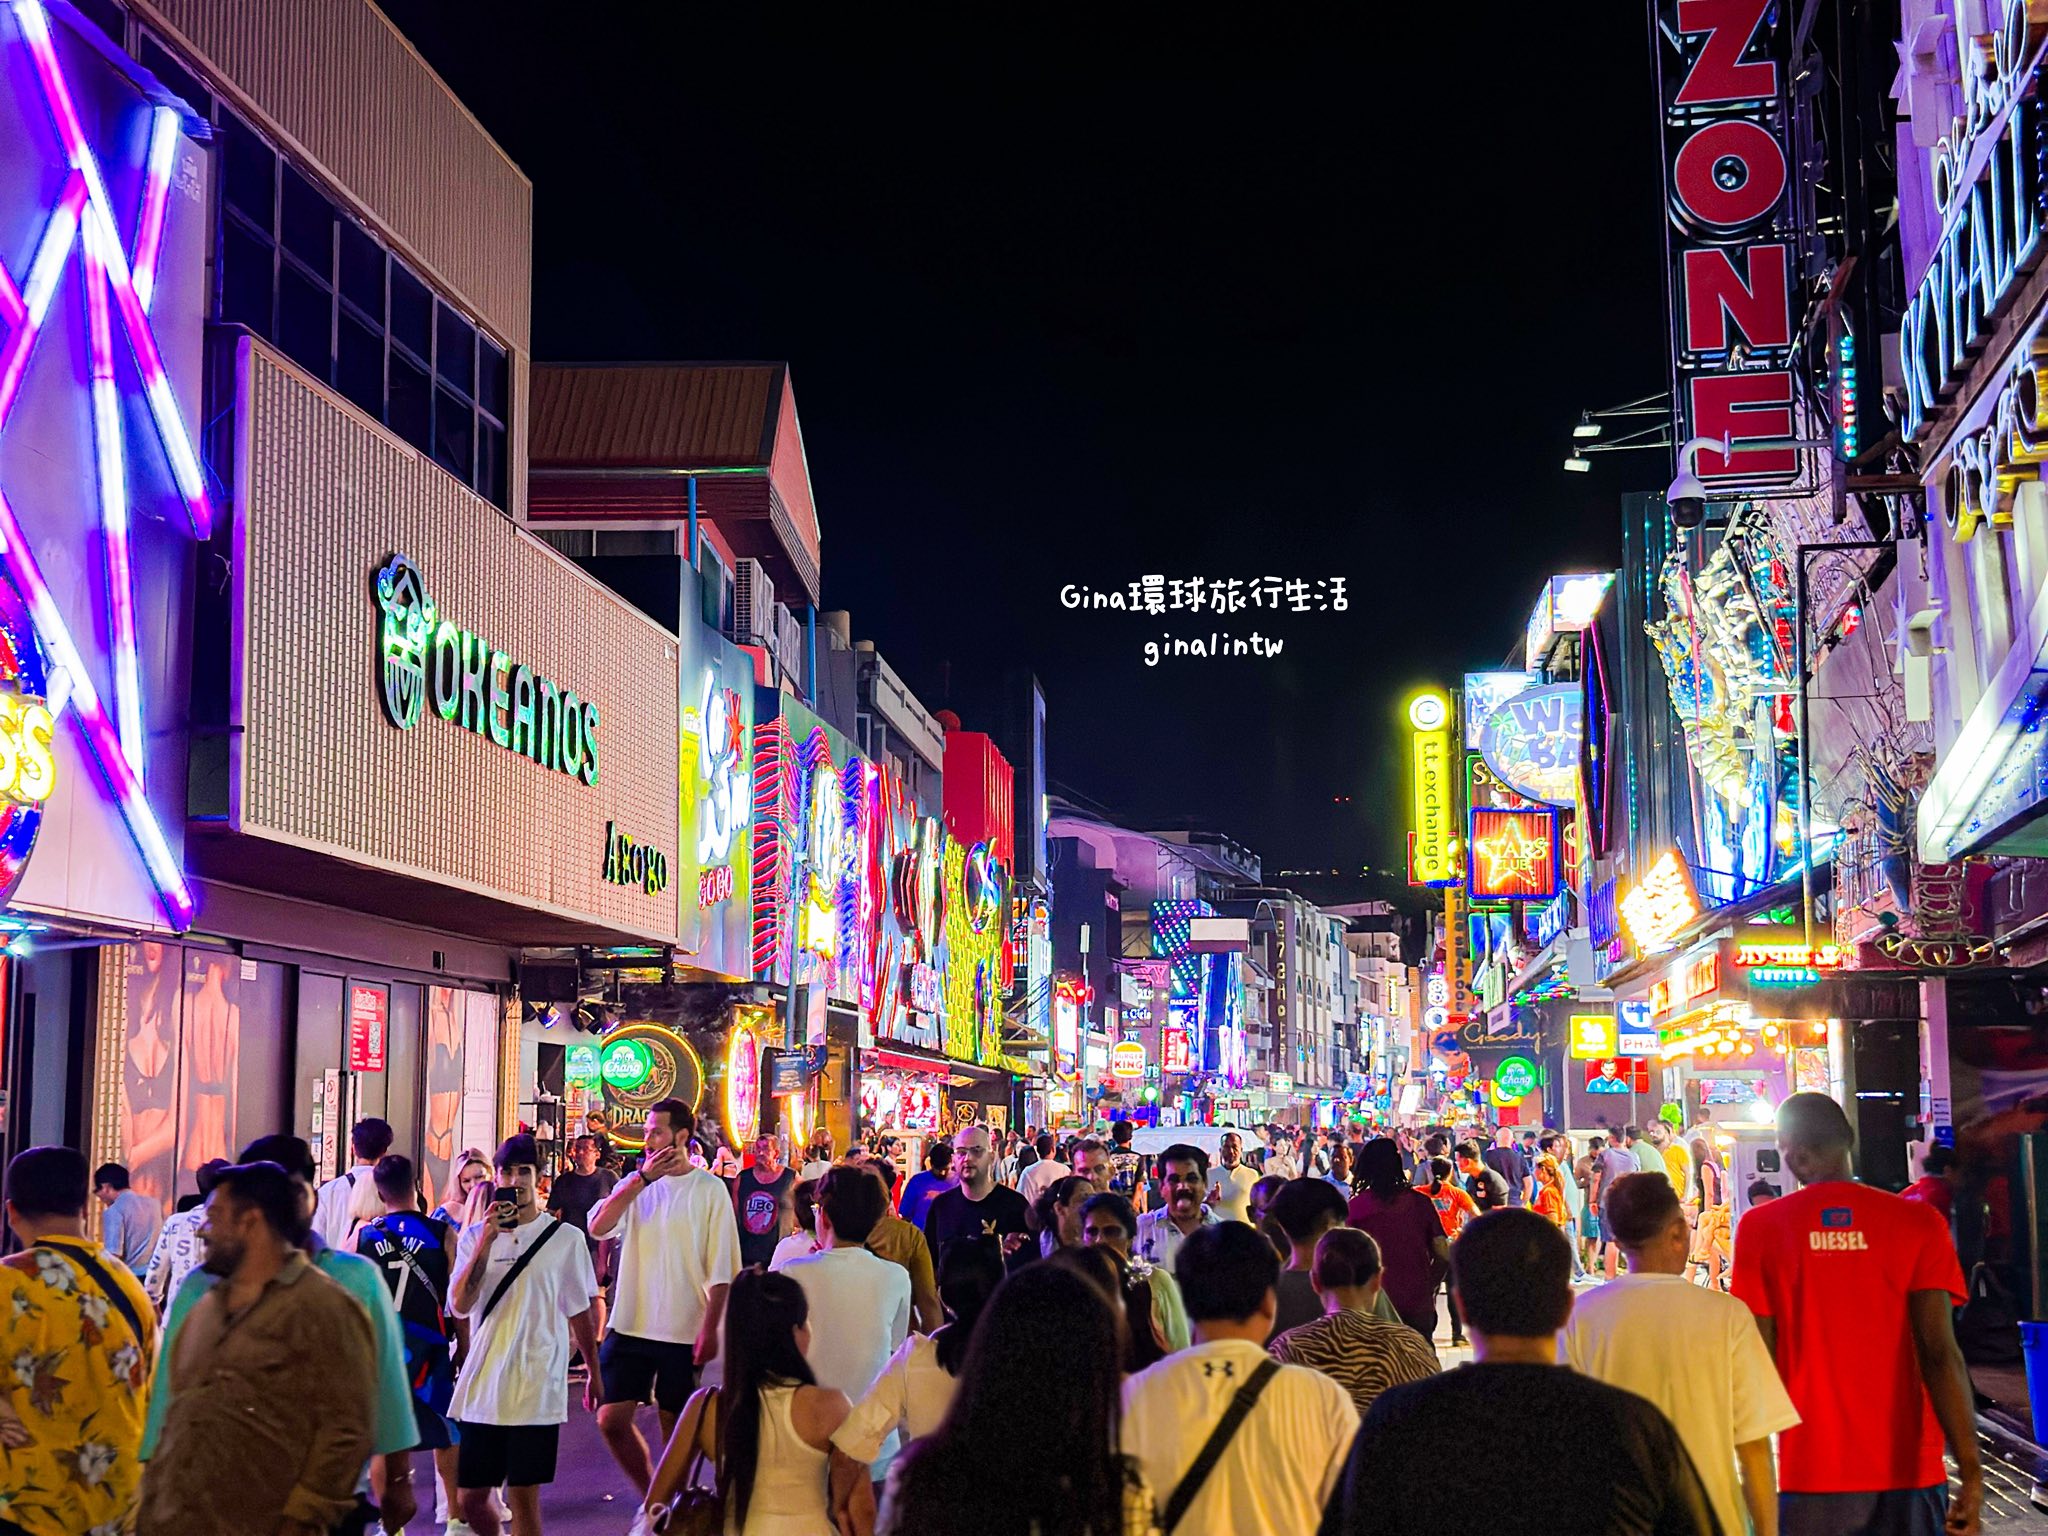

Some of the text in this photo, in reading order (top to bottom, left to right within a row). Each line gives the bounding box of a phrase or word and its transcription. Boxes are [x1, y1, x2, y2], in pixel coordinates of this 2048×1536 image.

[1900, 102, 2040, 444] SKYFALL
[434, 620, 602, 788] OKEANOS
[606, 820, 670, 898] Agogo
[1477, 837, 1548, 860] STARS
[1623, 1038, 1660, 1050] PHA
[605, 1060, 641, 1075] Chang
[1114, 1060, 1144, 1070] KING
[1501, 1073, 1532, 1089] Chang
[747, 1199, 774, 1213] LEO
[374, 1236, 425, 1257] DUANT
[1809, 1230, 1869, 1251] DIESEL
[387, 1260, 411, 1313] 7
